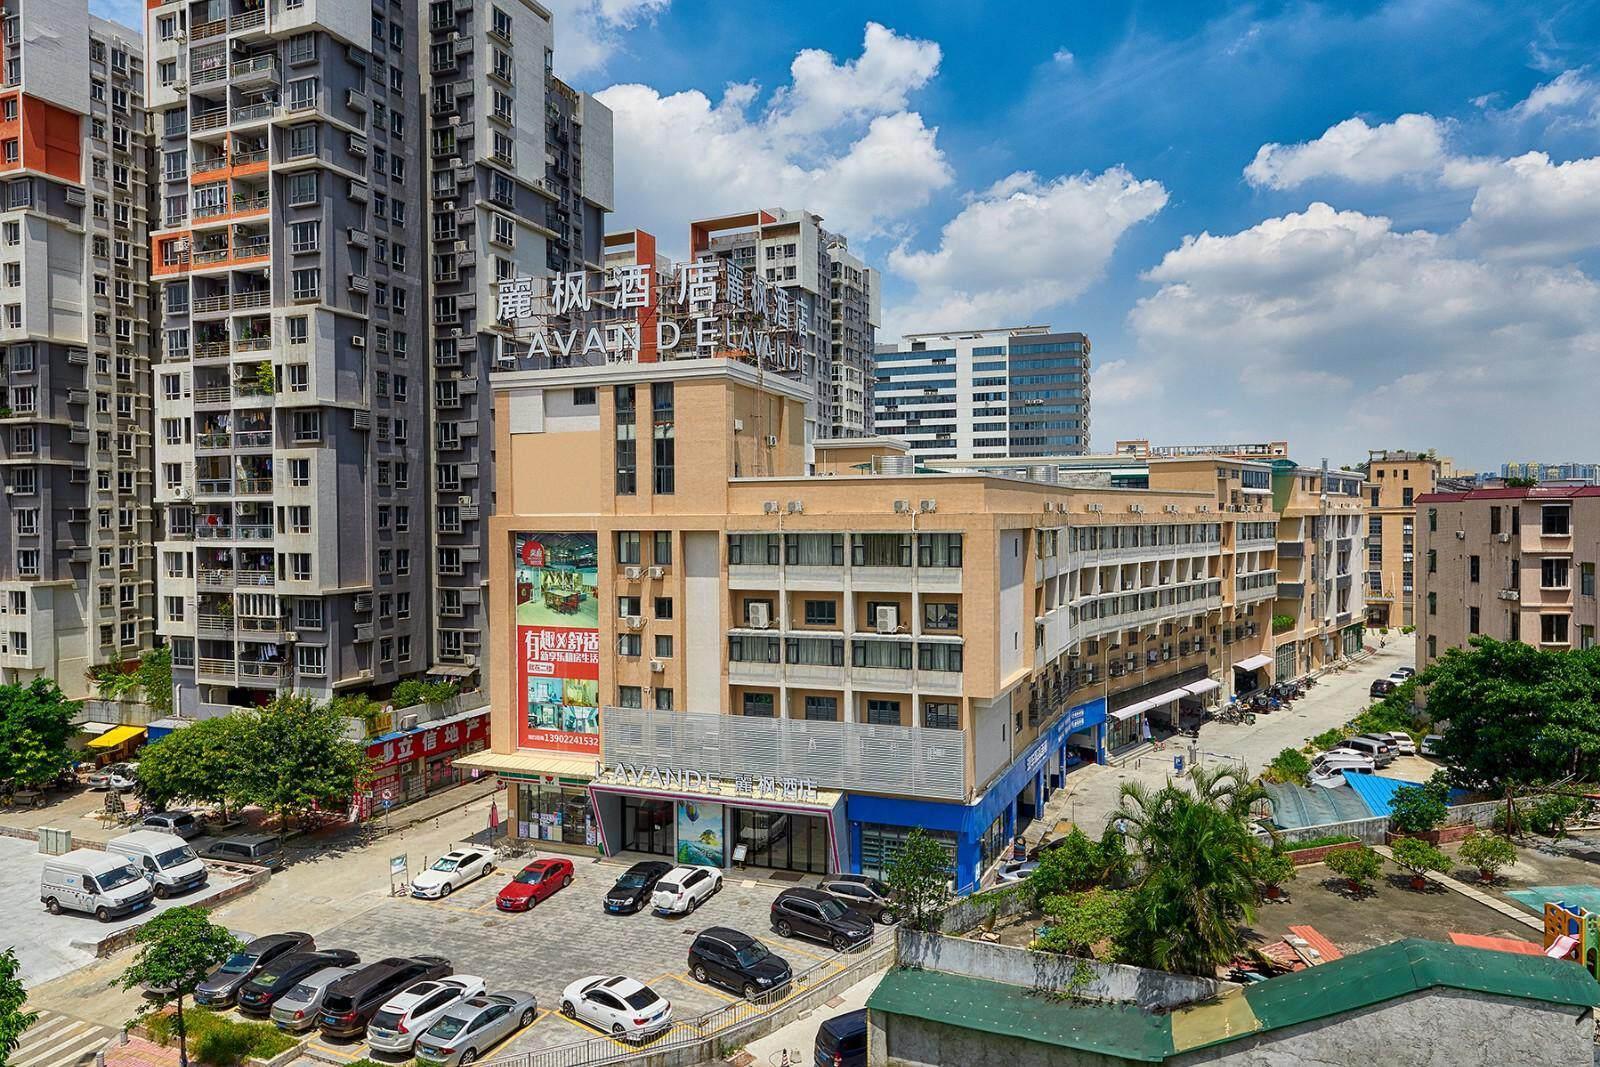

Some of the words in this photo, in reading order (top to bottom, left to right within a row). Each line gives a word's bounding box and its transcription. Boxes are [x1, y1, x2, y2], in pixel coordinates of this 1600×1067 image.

[496, 317, 719, 361] LAVANDE
[544, 733, 599, 746] 13902241532
[594, 760, 721, 792] LAVANDE
